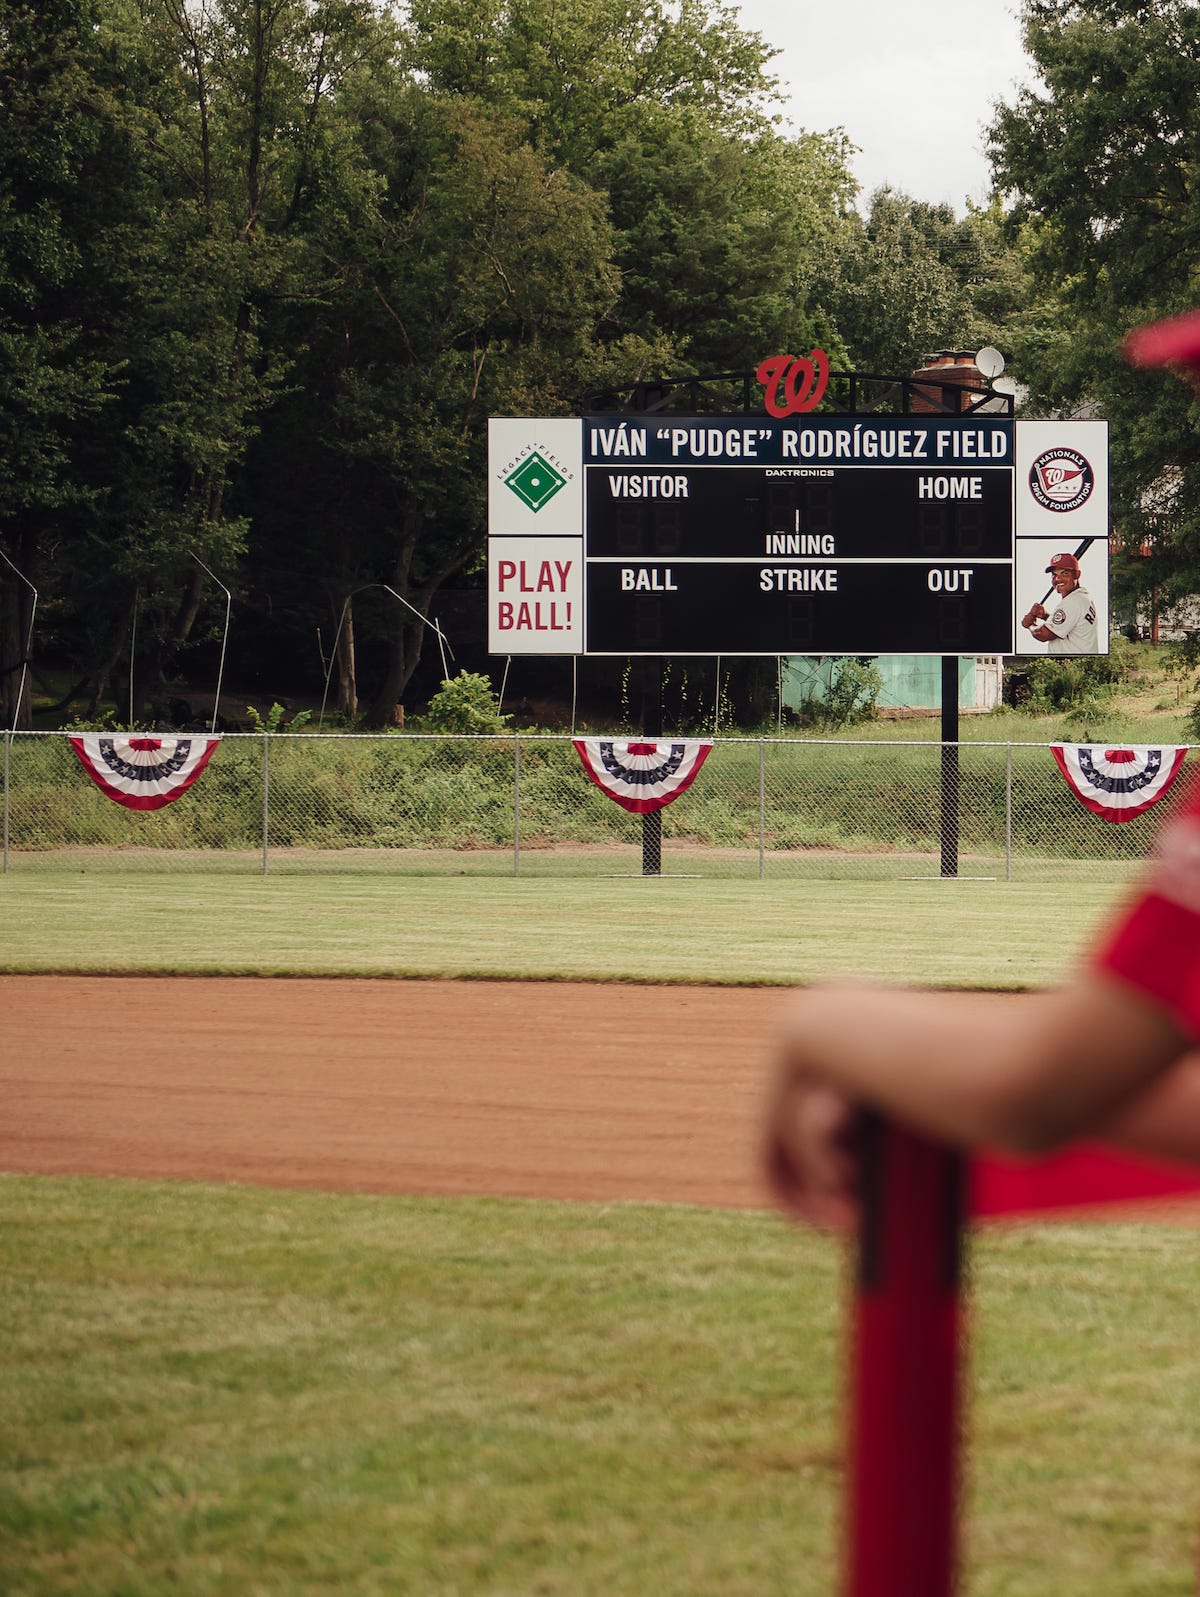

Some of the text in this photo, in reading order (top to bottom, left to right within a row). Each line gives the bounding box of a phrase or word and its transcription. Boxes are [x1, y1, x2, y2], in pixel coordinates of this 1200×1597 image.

[756, 348, 829, 418] W
[590, 422, 1007, 458] IVÁN “PUDGE” RODRÍGUEZ FIELD
[497, 445, 574, 479] LEGACY FIELDS
[1039, 451, 1084, 465] NATIONALS
[765, 469, 834, 477] DAKTRONICS
[609, 475, 689, 498] VISITOR
[918, 476, 983, 499] HOME
[1032, 482, 1091, 509] DREAM FOUNDATION
[765, 534, 835, 555] INNING
[498, 560, 573, 593] PLAY
[621, 568, 678, 591] BALL
[759, 568, 838, 592] STRIKE
[927, 568, 973, 592] OUT
[498, 601, 572, 631] BALL!
